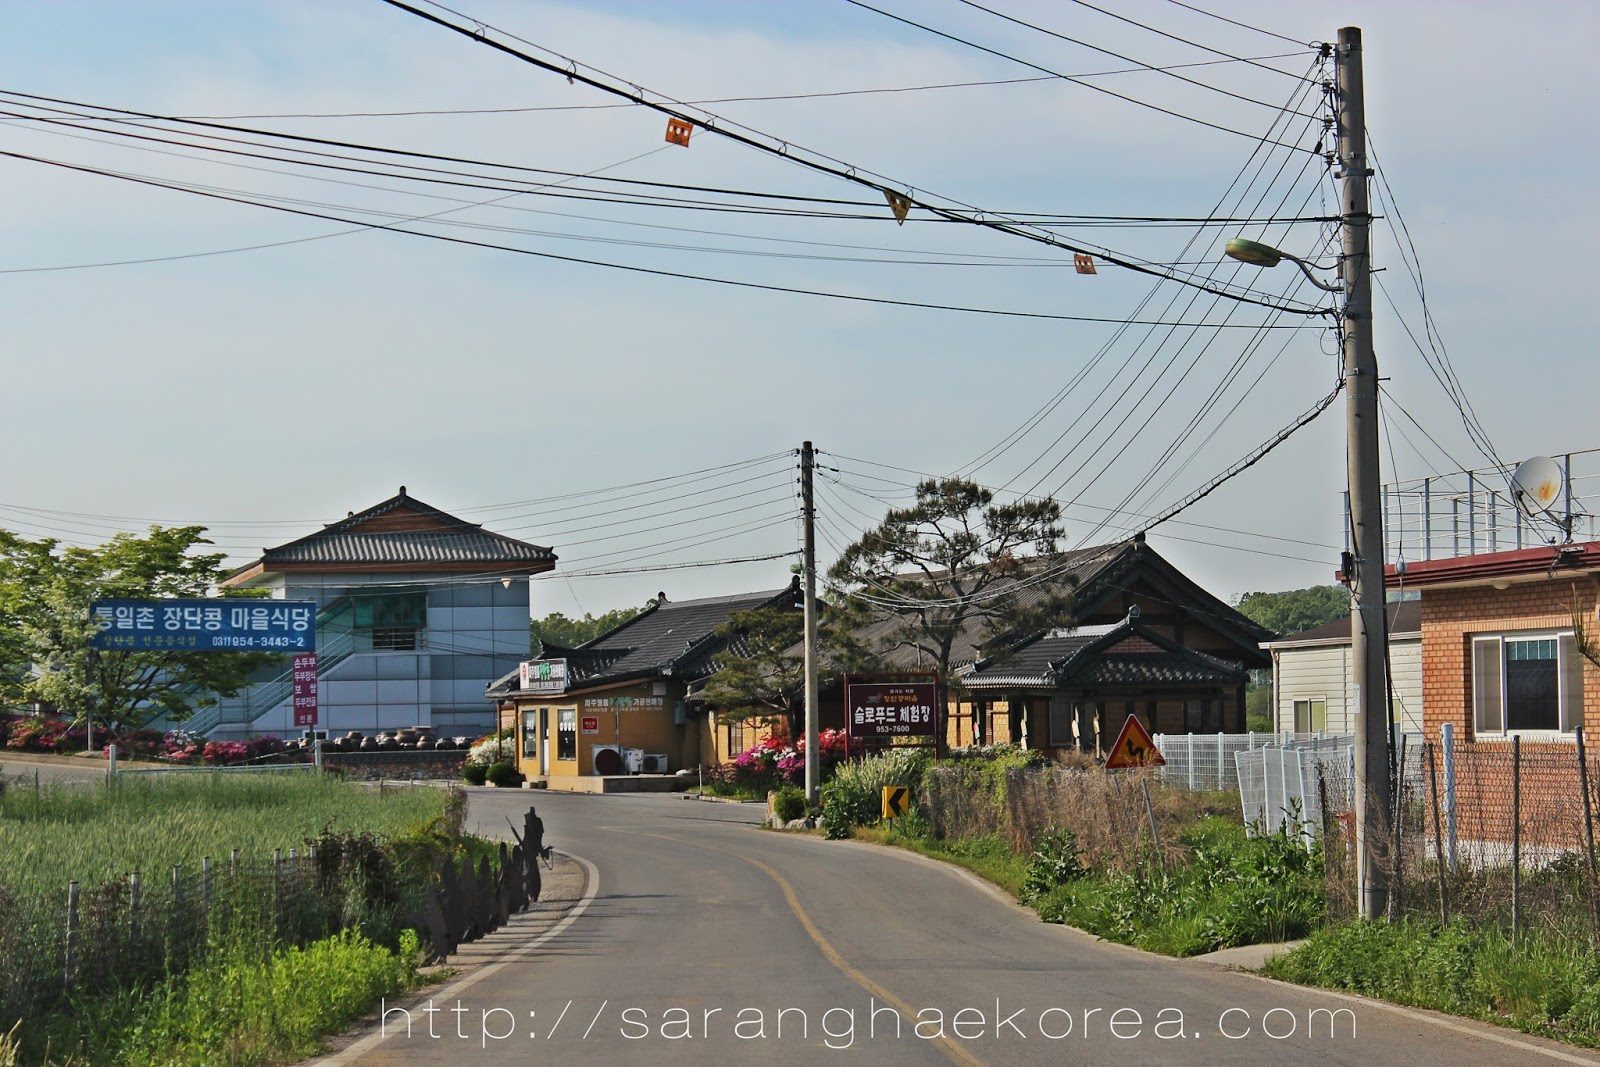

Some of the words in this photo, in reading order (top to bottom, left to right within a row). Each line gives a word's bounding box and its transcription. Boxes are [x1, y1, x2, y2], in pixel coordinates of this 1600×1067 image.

[95, 606, 155, 632] 통일촌
[163, 607, 222, 632] 장단콩
[231, 607, 310, 632] 마을식당
[294, 657, 316, 669] 손두부
[854, 706, 897, 725] 슬로푸드
[899, 705, 931, 723] 체험장
[875, 725, 910, 733] 953-7600
